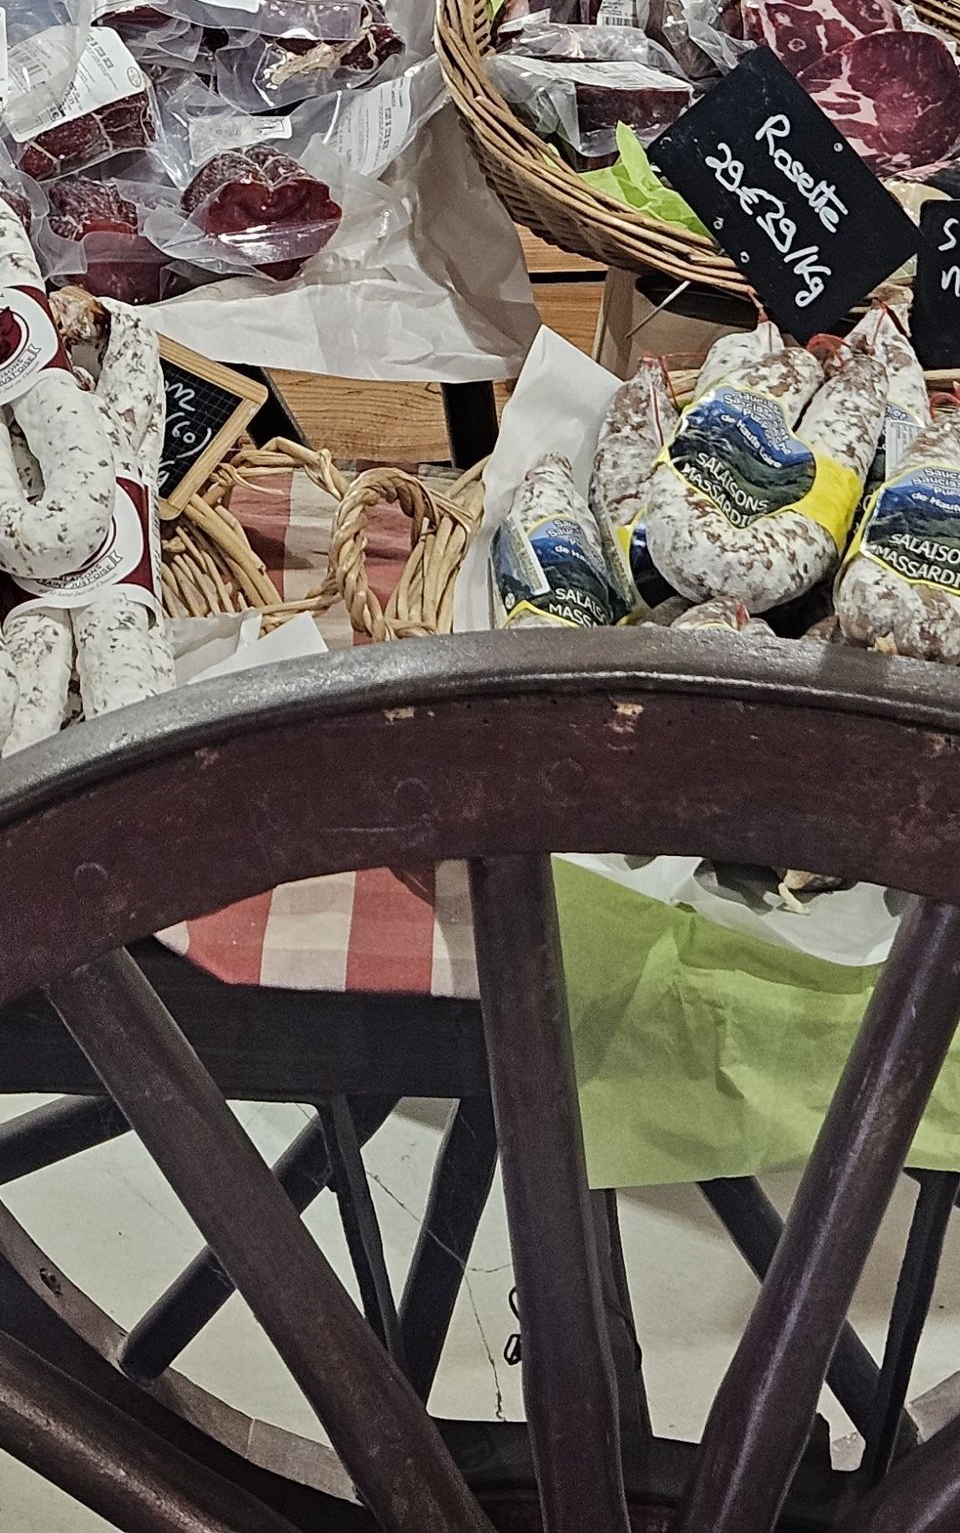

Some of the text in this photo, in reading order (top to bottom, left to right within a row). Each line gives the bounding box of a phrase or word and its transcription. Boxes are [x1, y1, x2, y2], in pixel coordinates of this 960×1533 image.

[755, 114, 849, 233] Rosette
[683, 462, 754, 527] MASSARDI
[696, 452, 770, 512] SALAISONS
[930, 496, 960, 512] Haut
[877, 545, 960, 586] MASSARDI
[889, 533, 960, 562] SALAISO
[555, 587, 607, 623] SALAIS
